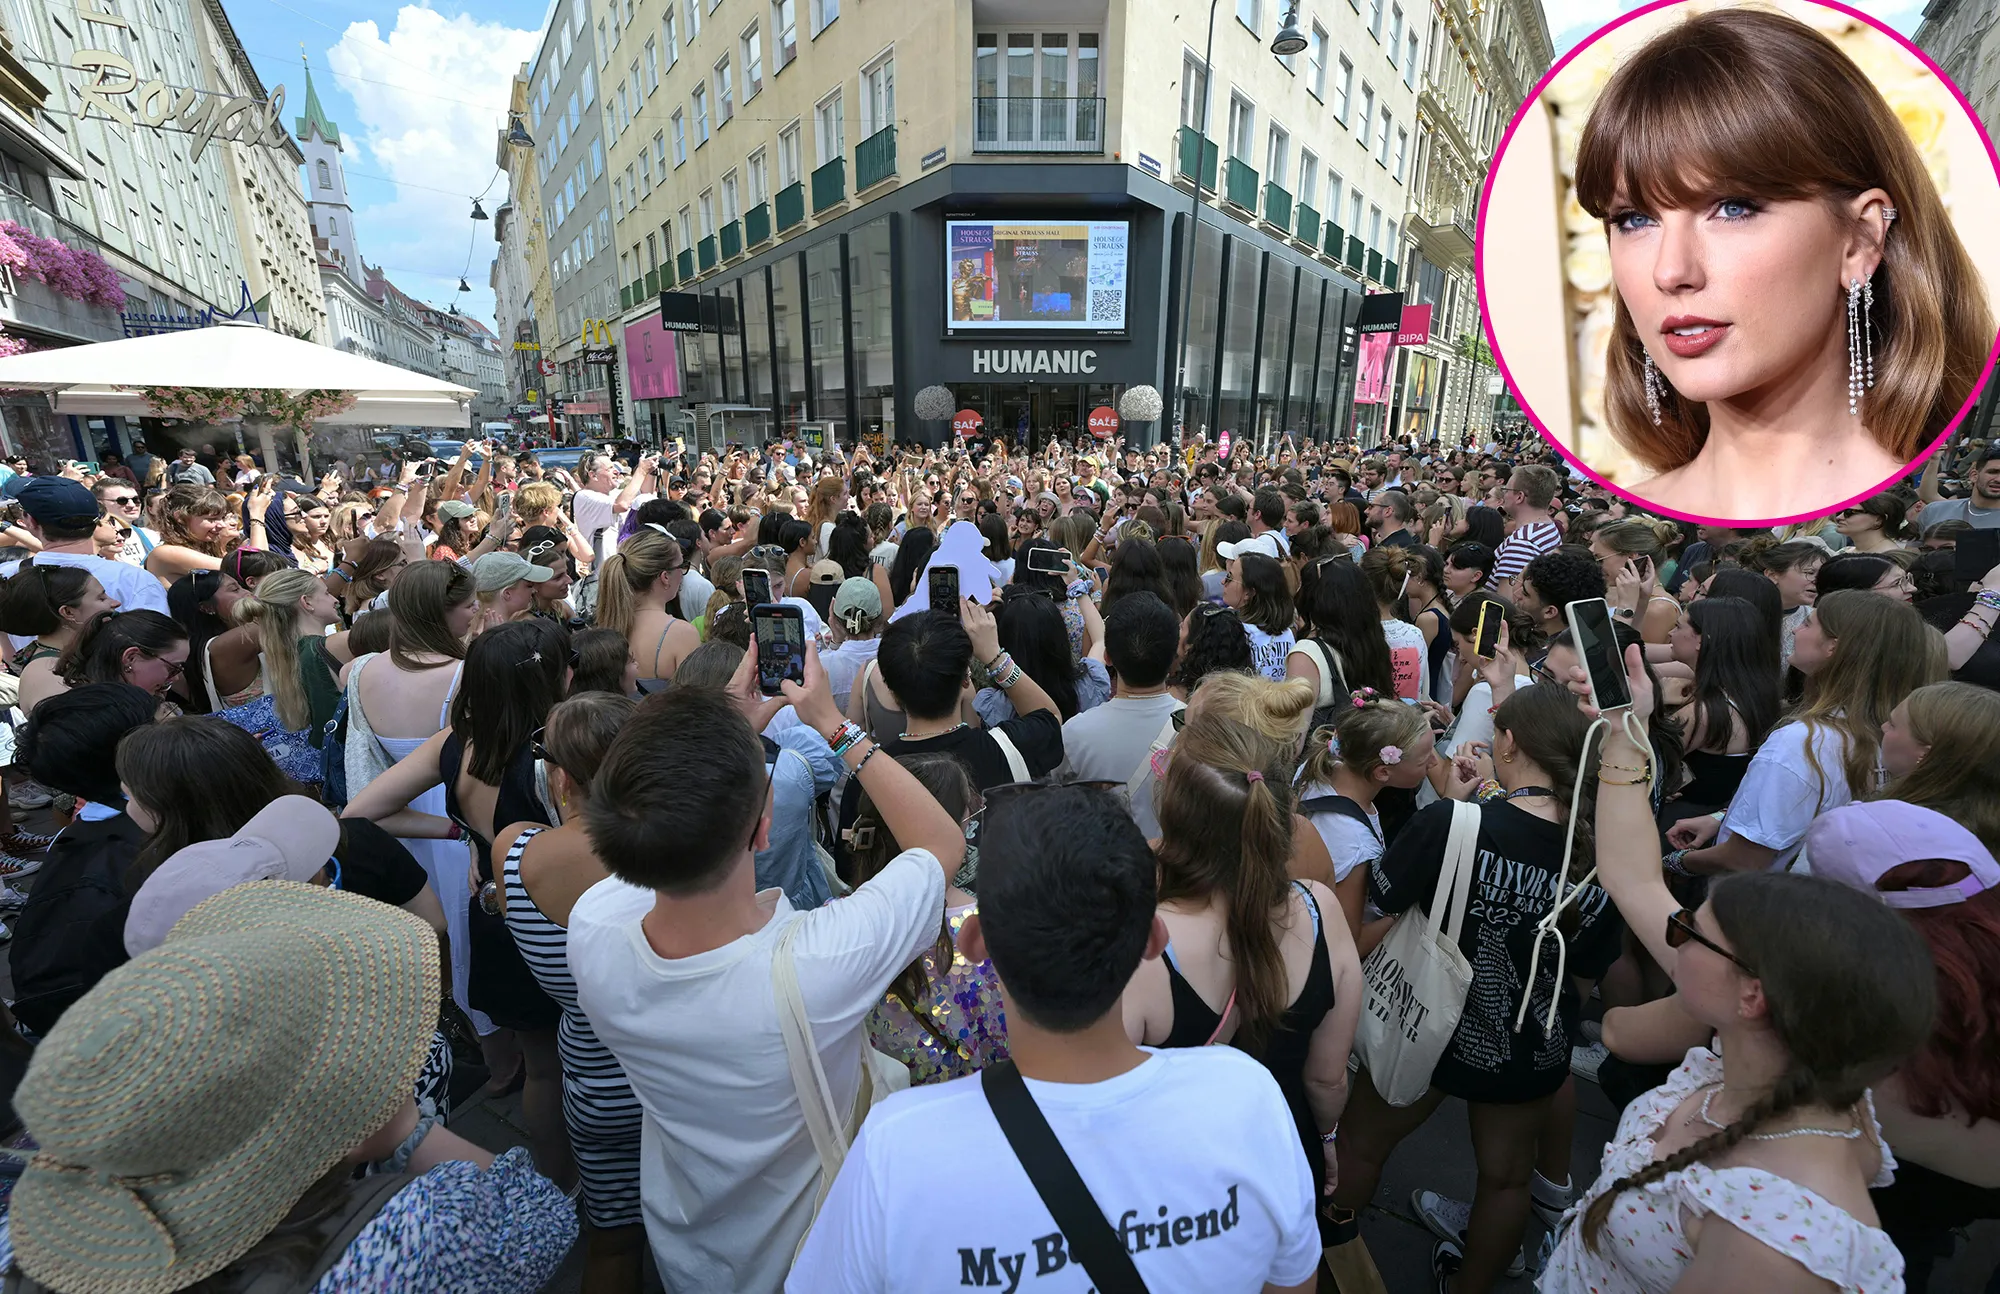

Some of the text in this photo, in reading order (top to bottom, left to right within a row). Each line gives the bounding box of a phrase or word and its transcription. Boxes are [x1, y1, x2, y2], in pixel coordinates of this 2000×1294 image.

[71, 49, 289, 164] Royal
[120, 312, 201, 324] RISTORANTE
[665, 321, 699, 330] HUMANIC
[1362, 323, 1398, 332] HUMANIC
[1398, 333, 1424, 343] BIPA
[973, 350, 1097, 374] HUMANIC
[1089, 417, 1118, 427] SALE
[1478, 848, 1548, 898] TAYLOR
[1478, 880, 1511, 904] THE
[957, 1247, 1026, 1294] My
